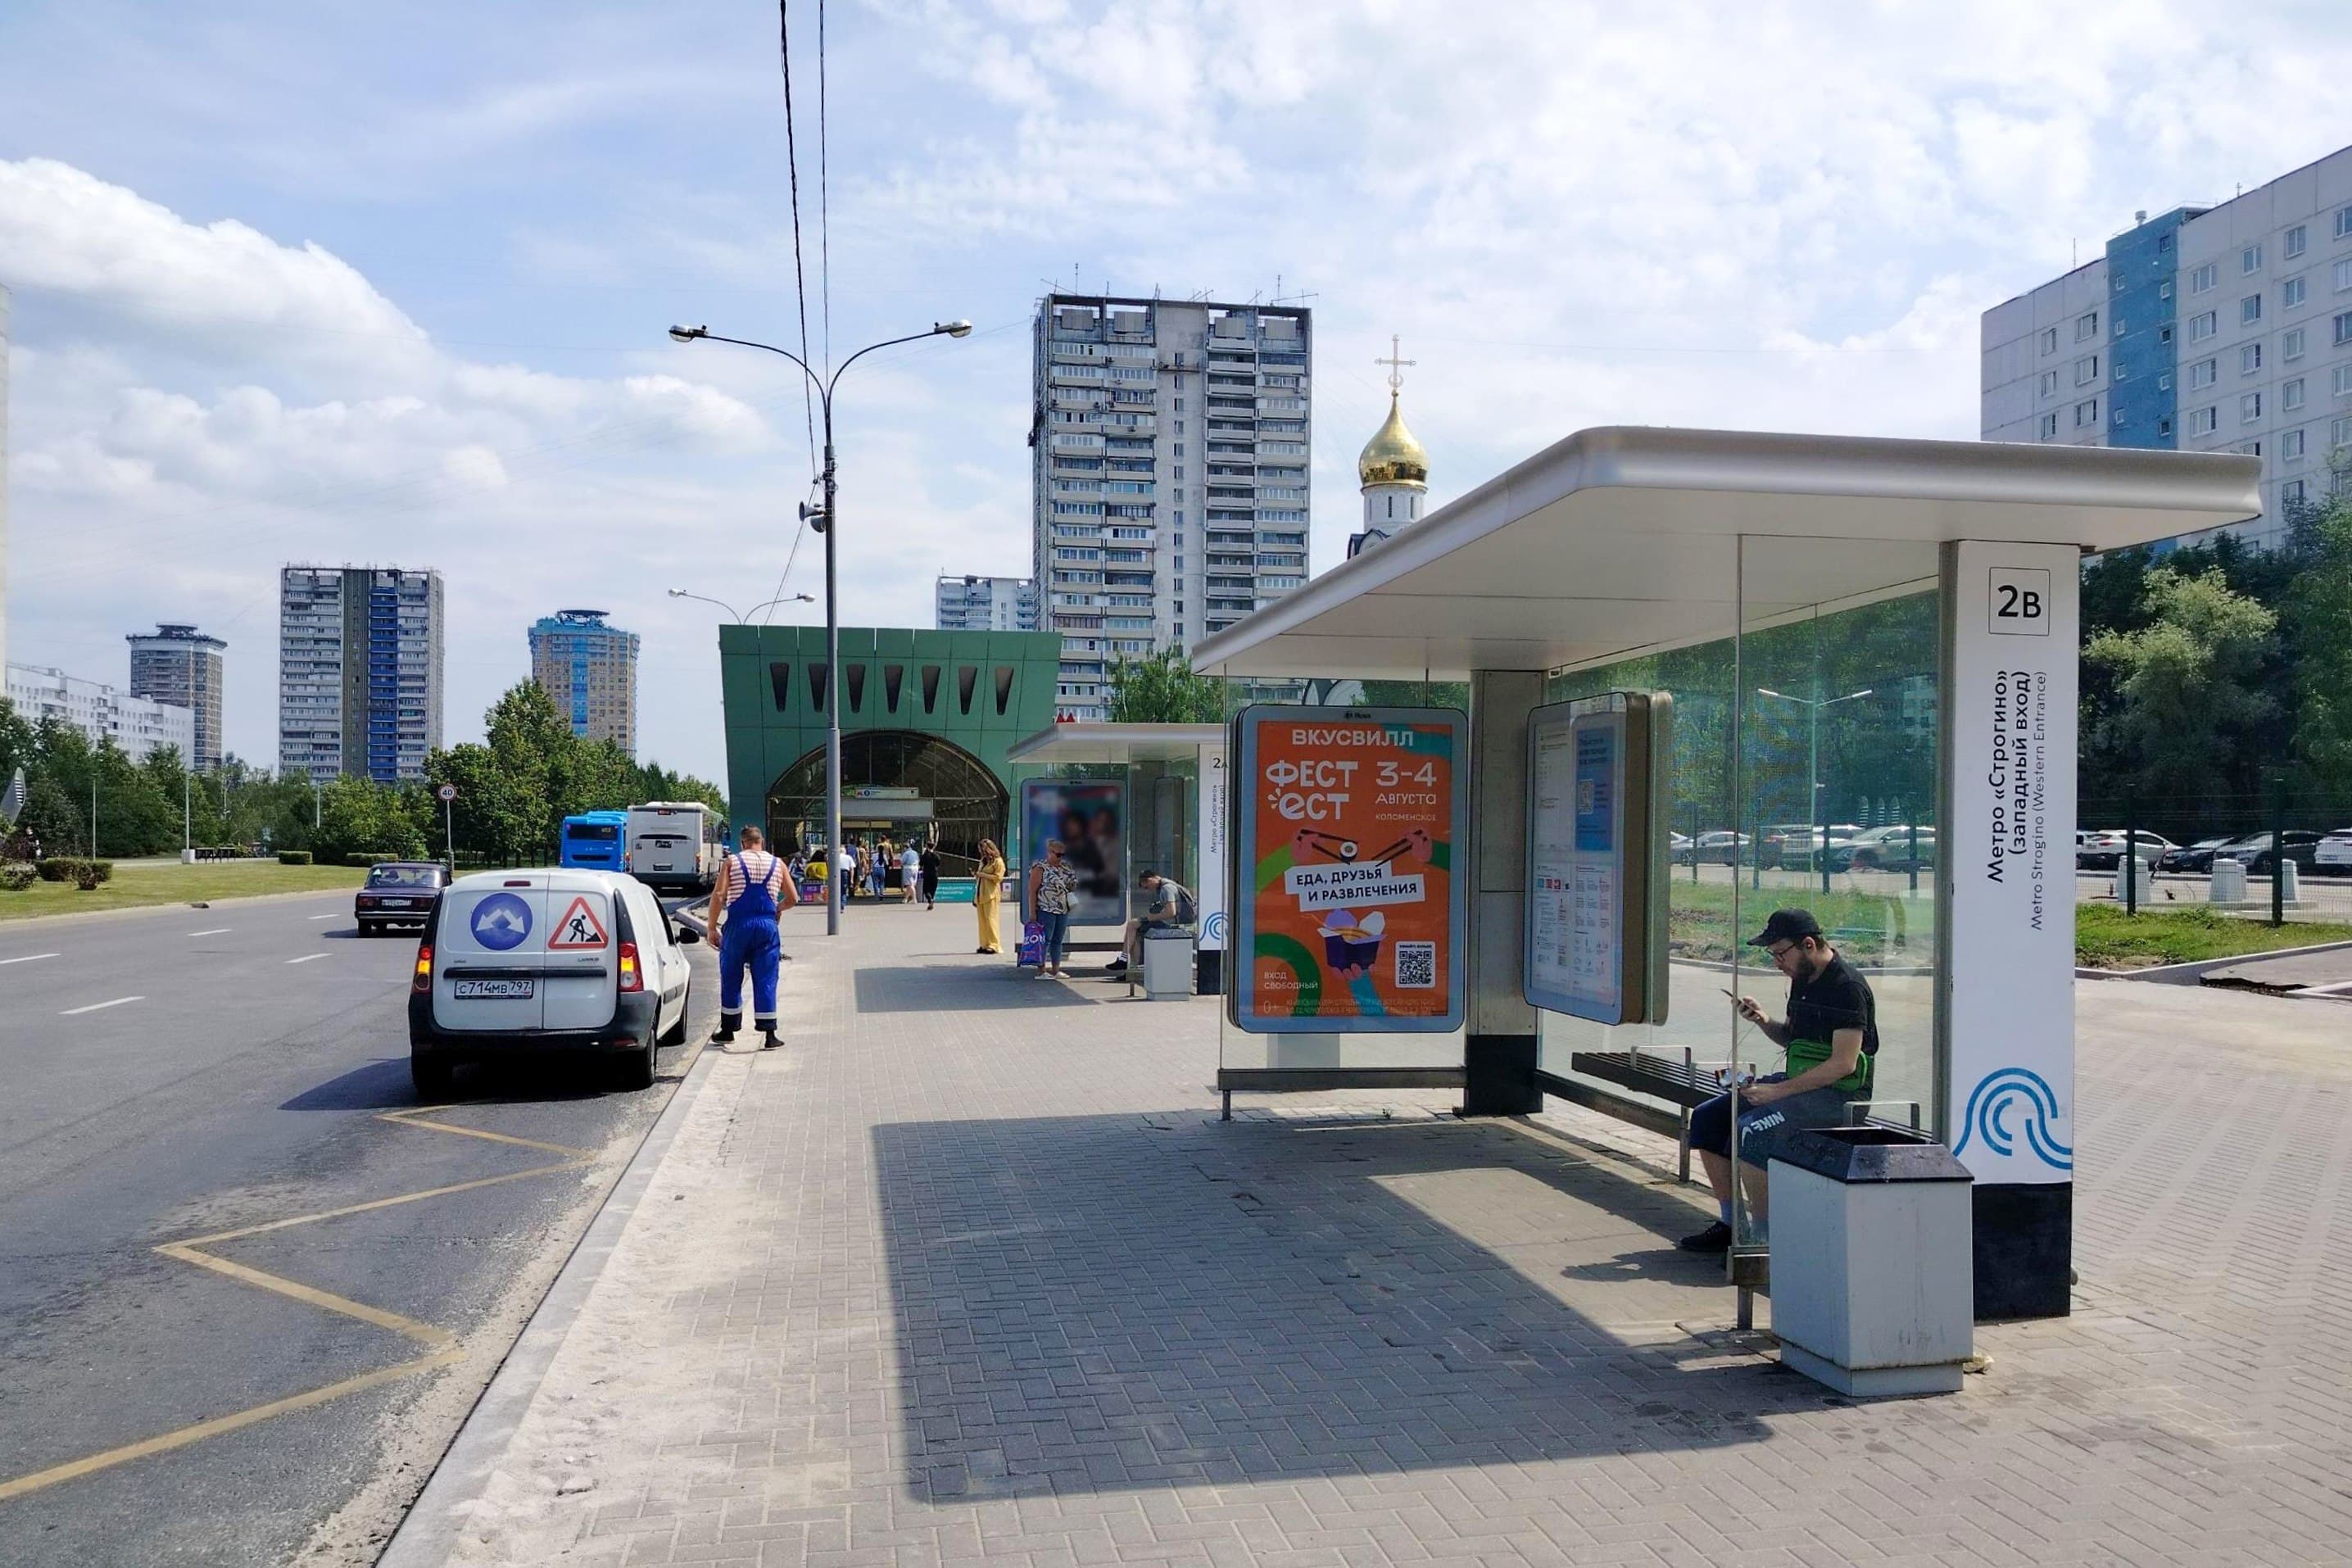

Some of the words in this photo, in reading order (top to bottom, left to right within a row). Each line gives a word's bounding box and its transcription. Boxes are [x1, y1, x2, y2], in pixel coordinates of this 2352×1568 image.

[2011, 671, 2031, 730] вход)
[2033, 671, 2046, 741] Entrance)
[1292, 729, 1414, 746] ВКУСВИЛЛ
[1988, 670, 2009, 800] «Строгино»
[1266, 759, 1358, 787] ФЕСТ
[1375, 761, 1437, 786] 3-4
[2032, 745, 2045, 812] (Western
[2008, 738, 2029, 854] (западный
[1375, 813, 1436, 821] КОЛОМЕНСКОЕ
[1987, 807, 2008, 883] Метро
[2032, 816, 2046, 880] Strogino
[1297, 873, 1327, 886] ЕДА,
[1331, 868, 1382, 885] ДРУЗЬЯ
[1308, 891, 1318, 901] И
[1322, 883, 1417, 900] РАЗВЛЕЧЕНИЯ
[2031, 884, 2042, 931] Metro
[510, 981, 529, 990] 797
[1264, 972, 1287, 980] ВХОД
[1264, 981, 1318, 990] СВОБОДНЫЙ
[1751, 1112, 1786, 1131] NIKE
